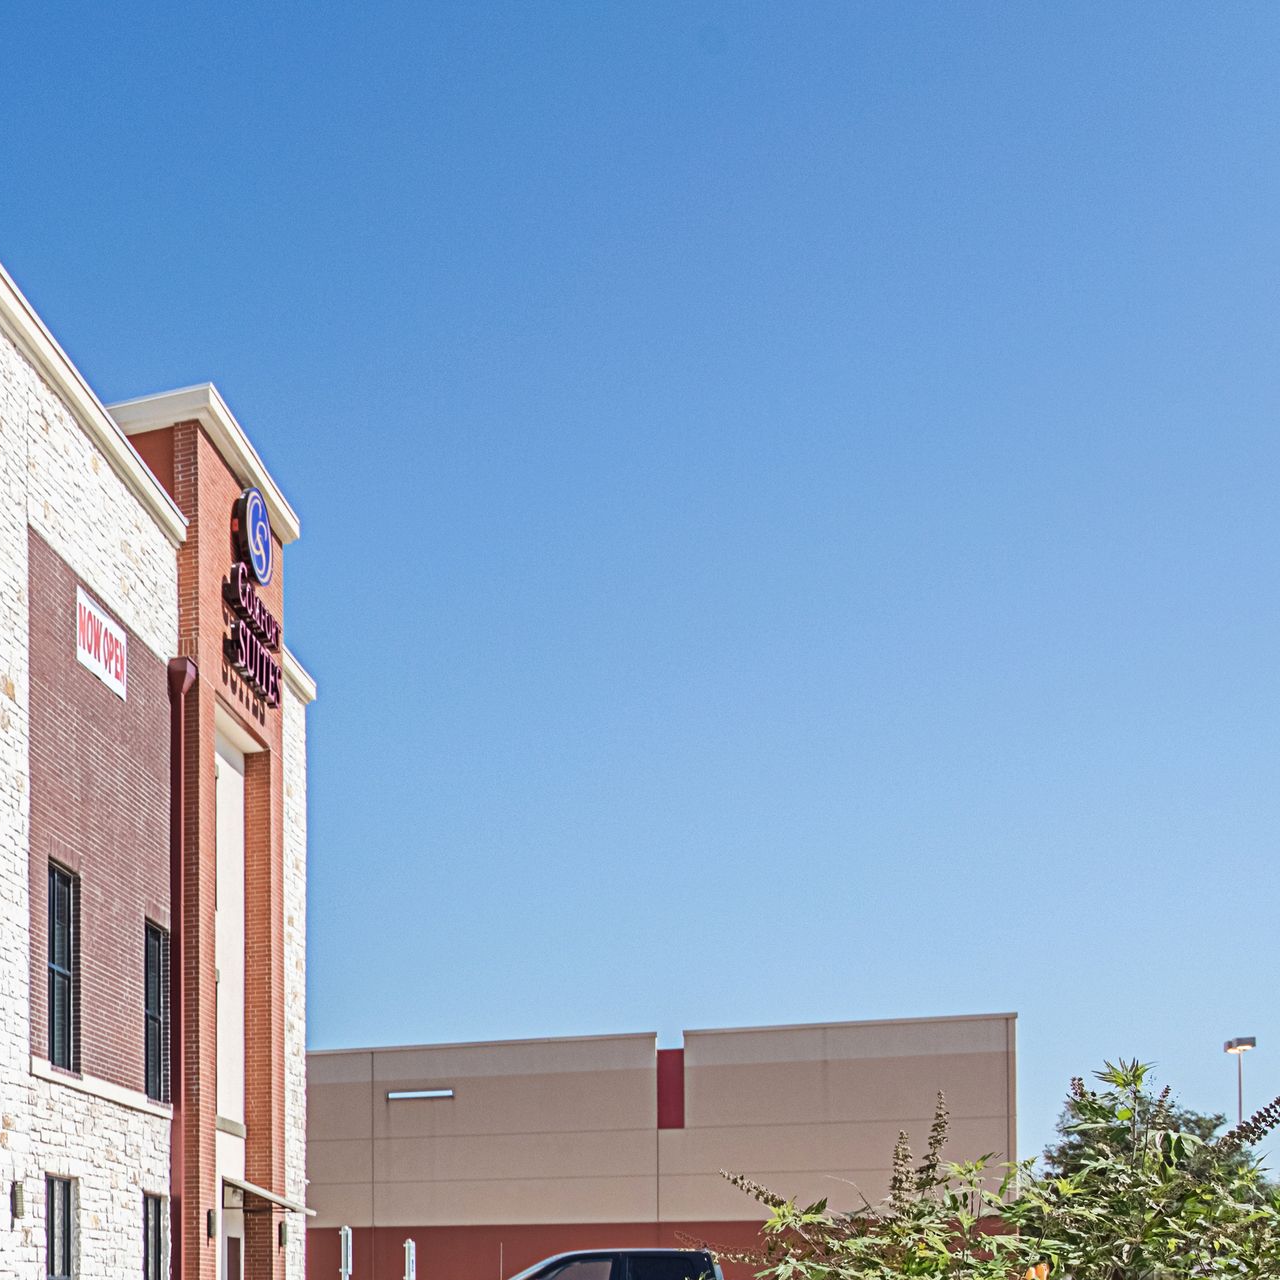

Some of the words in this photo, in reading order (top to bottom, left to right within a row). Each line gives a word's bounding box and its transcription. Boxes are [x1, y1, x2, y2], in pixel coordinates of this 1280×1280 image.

[79, 602, 102, 663] NOW
[103, 627, 125, 687] OPEN
[238, 619, 282, 709] SUITES
